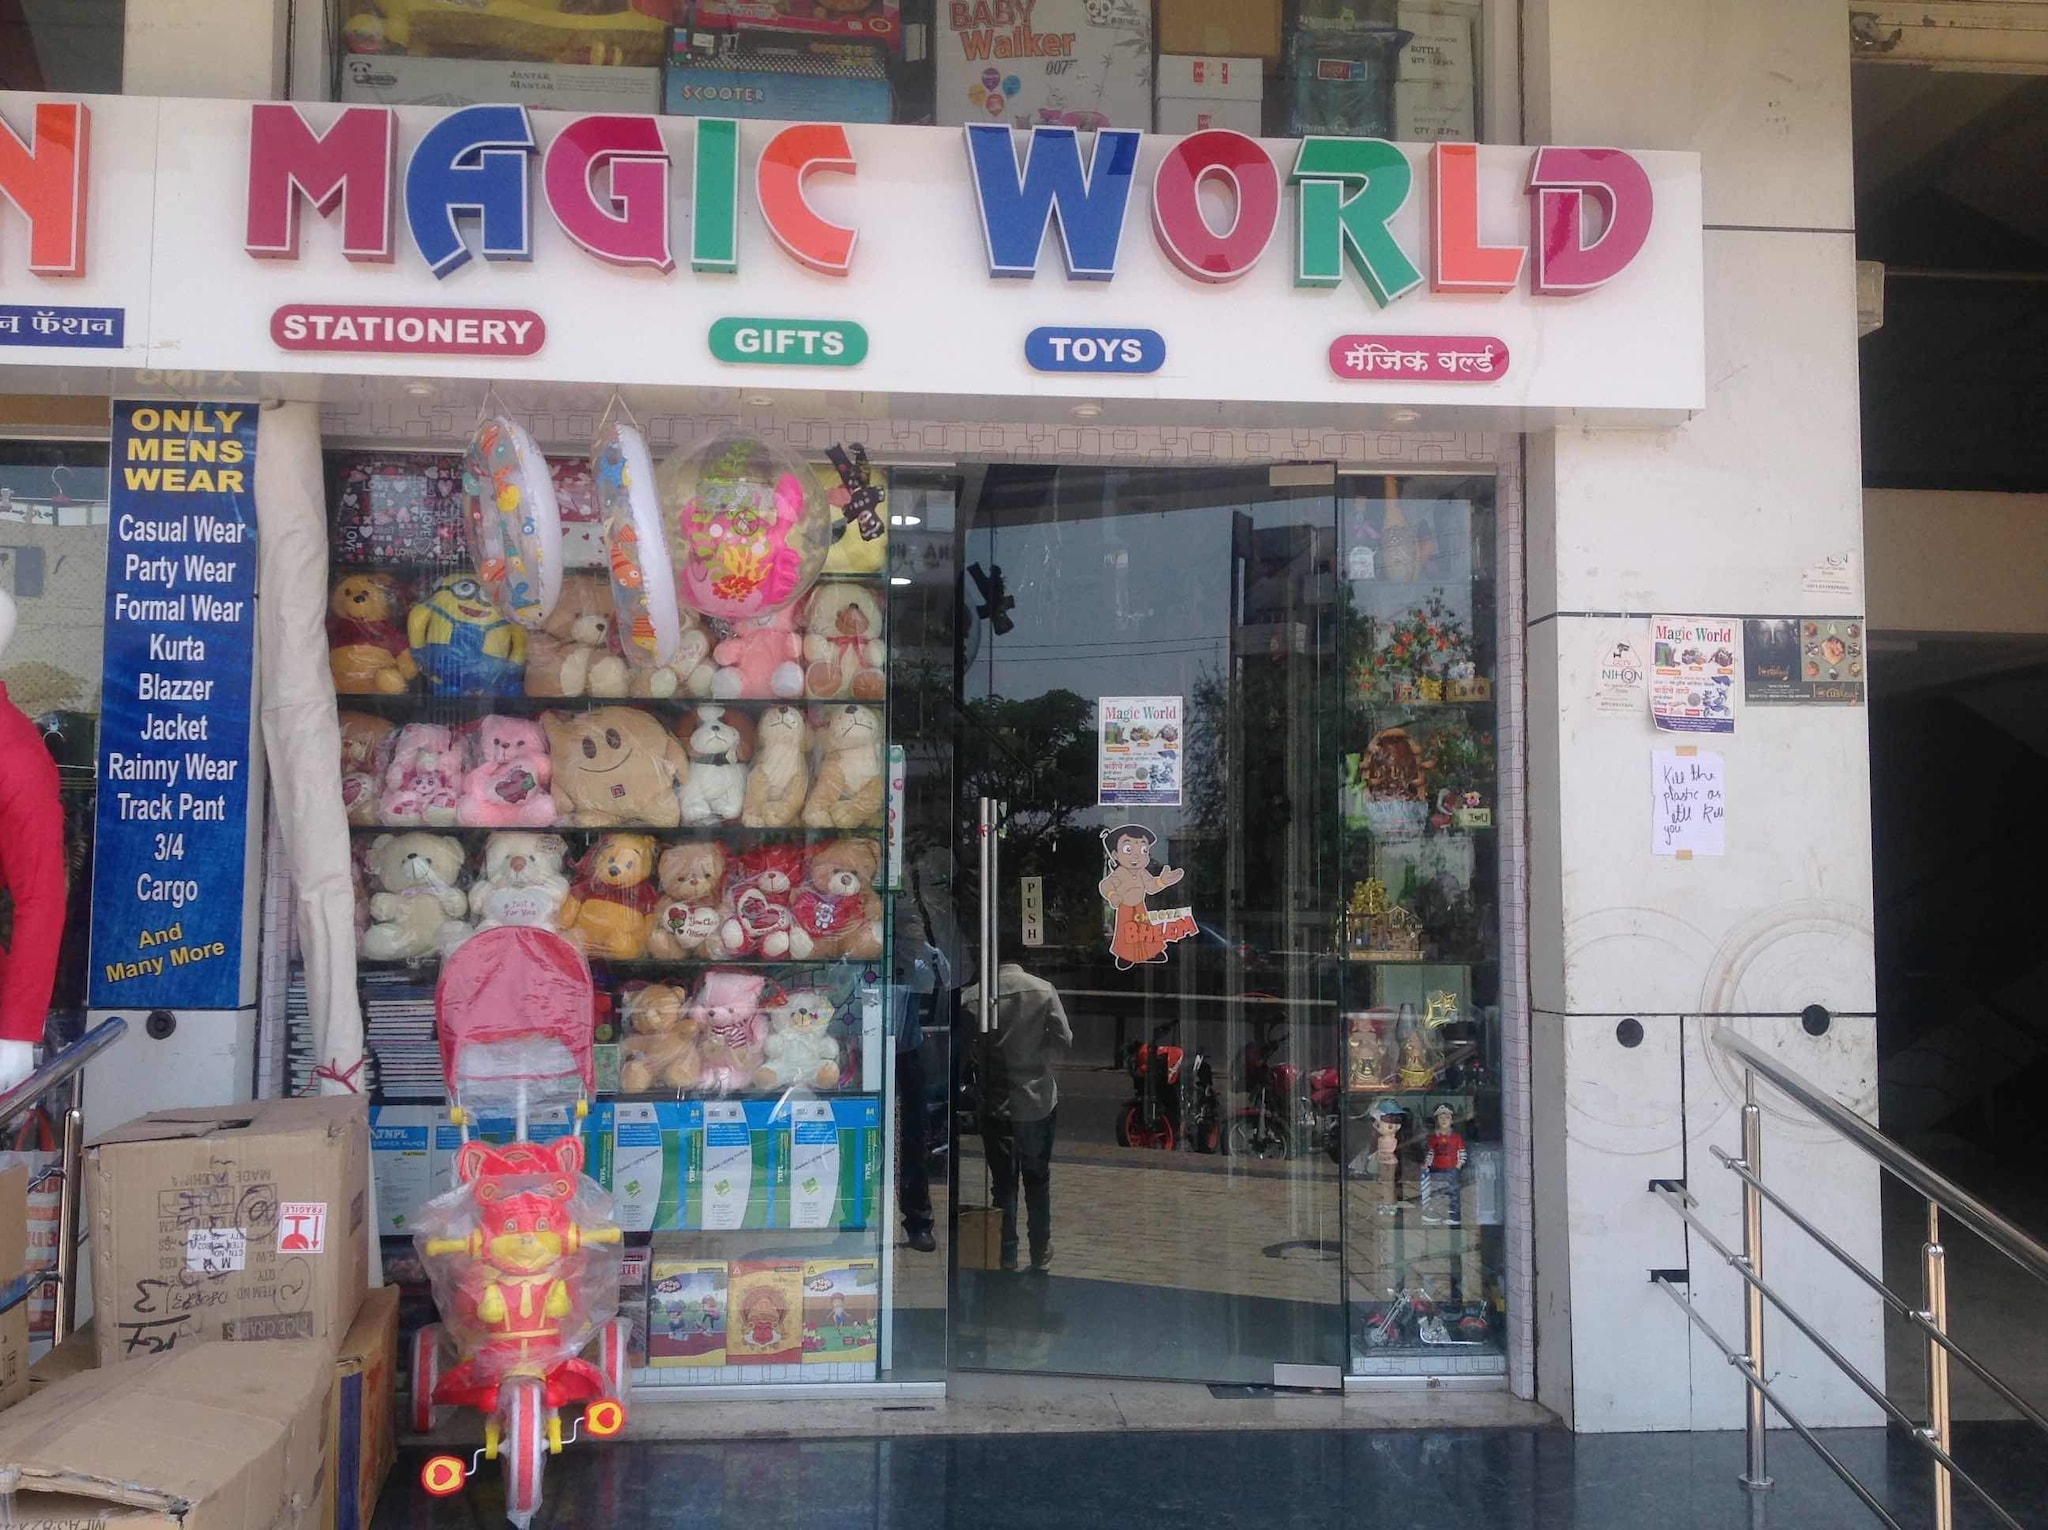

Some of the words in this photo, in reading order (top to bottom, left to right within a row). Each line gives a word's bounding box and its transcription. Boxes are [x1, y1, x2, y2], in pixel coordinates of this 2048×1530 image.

[950, 0, 1036, 31] BABY
[960, 27, 1077, 61] Walker
[1046, 60, 1077, 76] 007
[682, 84, 765, 102] SCOOTER
[244, 102, 860, 280] MAGIC
[964, 121, 1654, 308] WORLD
[282, 313, 533, 346] STATIONERY
[734, 328, 845, 356] GIFTS
[1048, 337, 1143, 364] TOYS
[131, 408, 243, 433] ONLY
[127, 438, 244, 463] MENS
[124, 467, 245, 494] WEAR
[118, 515, 188, 543] Casual
[193, 516, 245, 545] Wear
[125, 555, 177, 587] Party
[184, 556, 236, 584] Wear
[114, 594, 191, 621] Formal
[193, 595, 243, 625] Wear
[149, 633, 205, 662] Kurta
[1656, 625, 1692, 644] Magic
[1696, 627, 1731, 643] World
[138, 673, 214, 702] Blazzer
[140, 713, 208, 742] Jacket
[1105, 706, 1140, 723] Magic
[1143, 705, 1177, 720] World
[109, 752, 179, 788] Rainny
[184, 755, 238, 783] Wear
[118, 793, 173, 821] Track
[179, 793, 226, 822] Pant
[154, 833, 184, 861] 3/4
[136, 874, 199, 908] Cargo
[1026, 882, 1038, 940] PUSH
[138, 922, 184, 950] And
[104, 950, 164, 985] Many
[170, 938, 227, 968] More
[284, 1206, 323, 1216] FRAGILE
